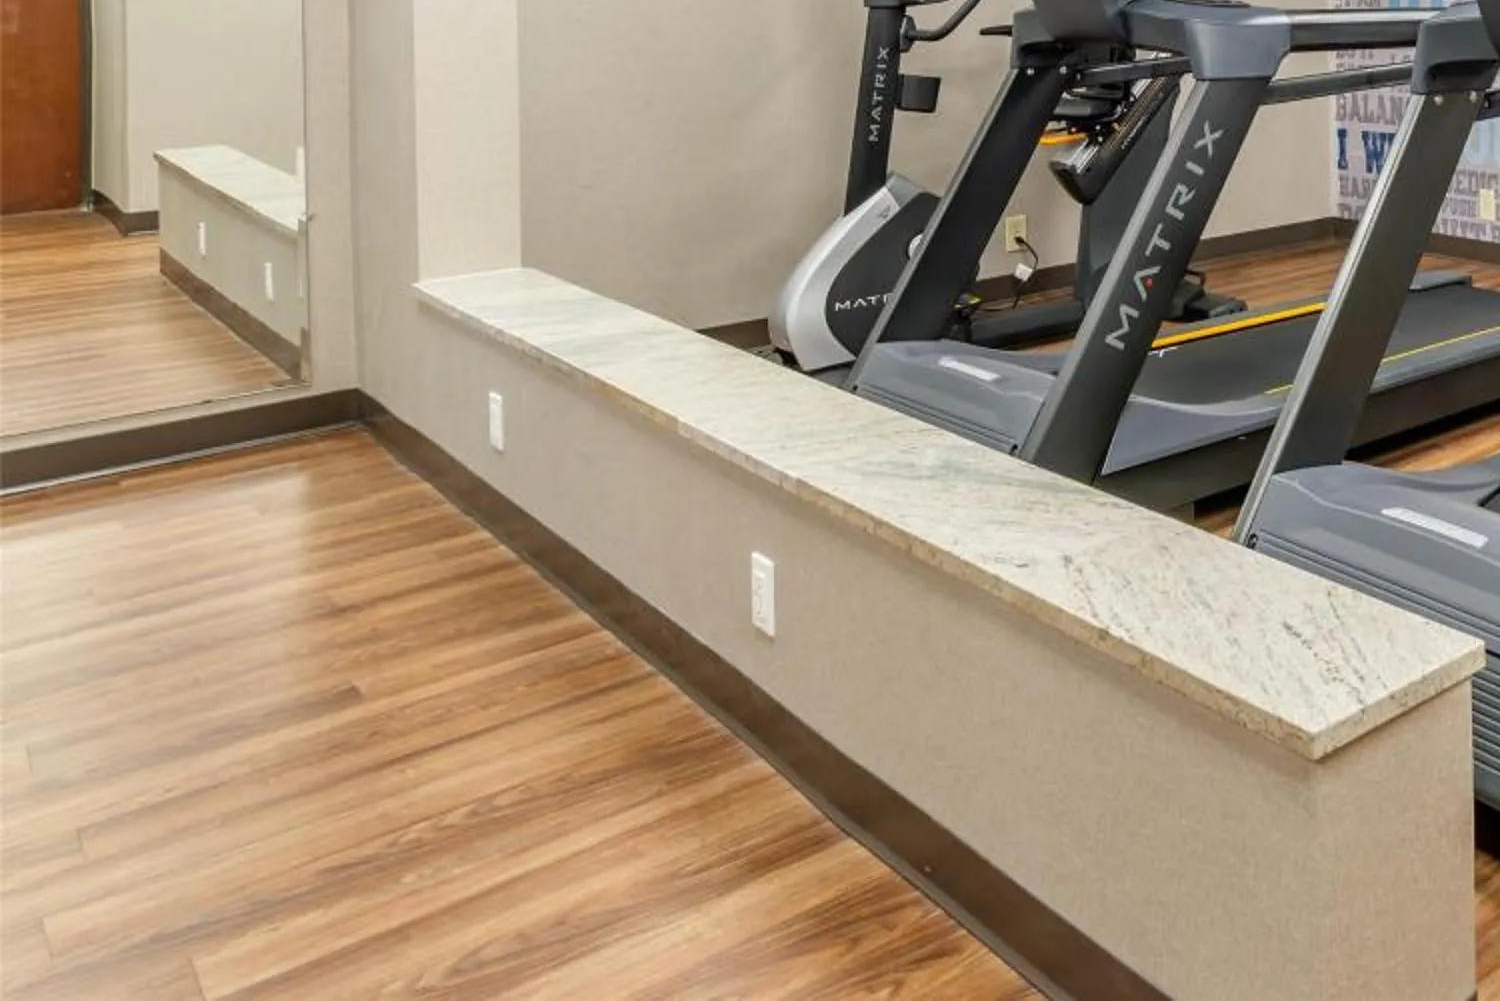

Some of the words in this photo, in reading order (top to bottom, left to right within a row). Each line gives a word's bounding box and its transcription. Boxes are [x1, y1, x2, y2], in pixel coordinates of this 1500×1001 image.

[867, 46, 890, 142] MATRIX
[1104, 120, 1225, 350] MATRIX
[835, 293, 893, 312] MAT
